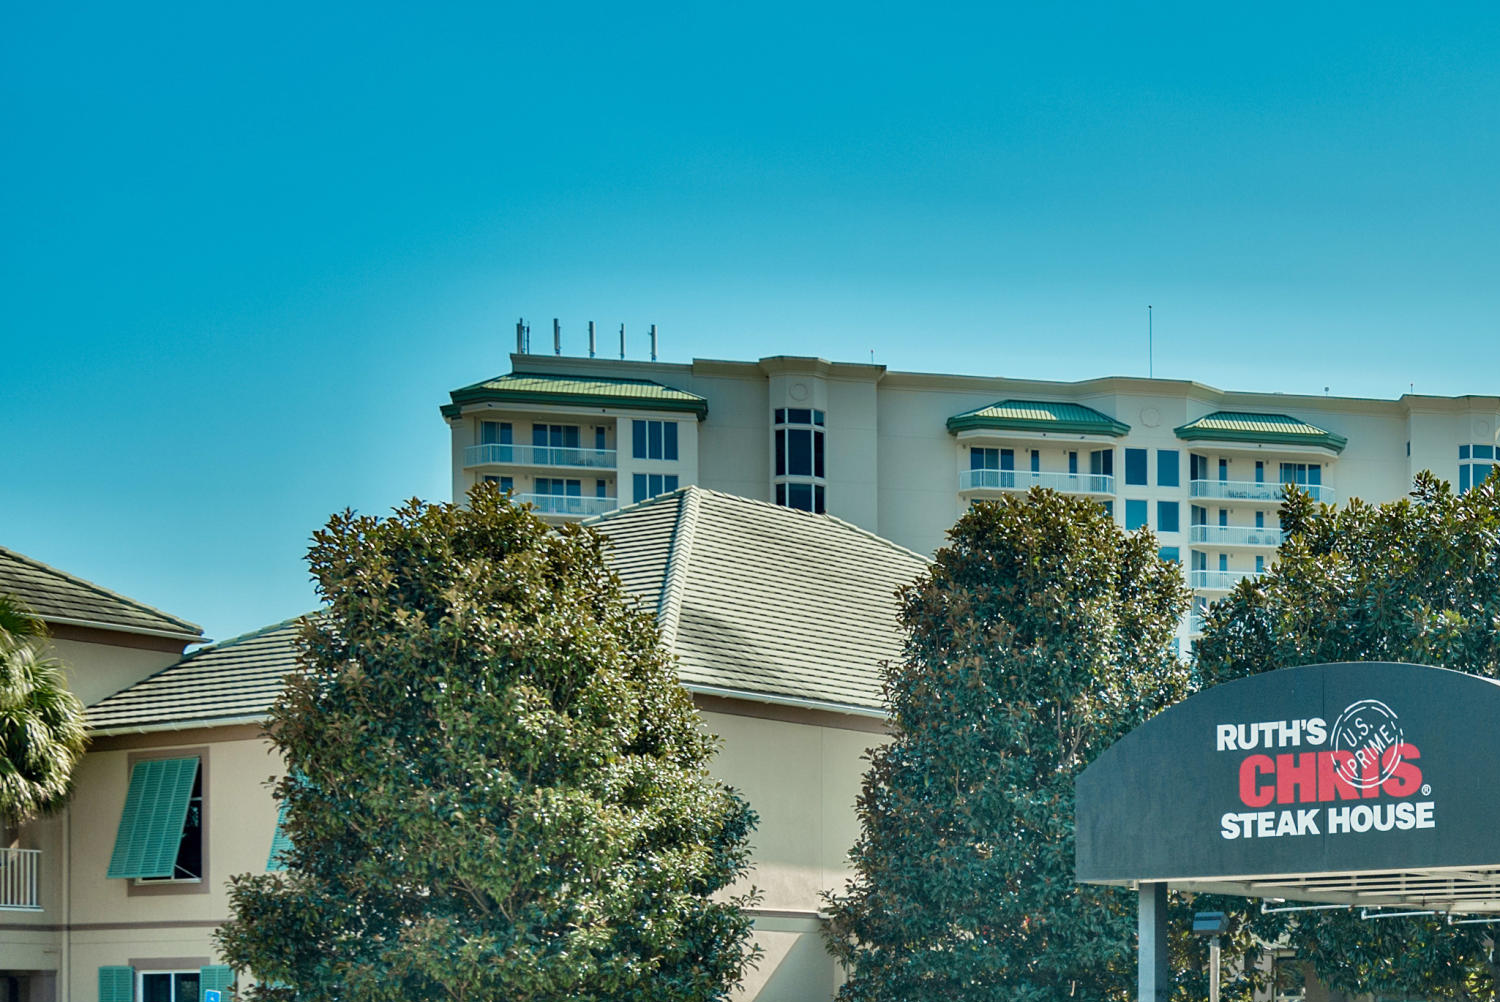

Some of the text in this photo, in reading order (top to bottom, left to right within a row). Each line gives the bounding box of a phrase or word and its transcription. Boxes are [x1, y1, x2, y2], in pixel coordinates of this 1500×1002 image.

[1216, 717, 1328, 752] RUTH'S
[1342, 717, 1374, 748] U.S.
[1346, 724, 1395, 778] PRIME
[1239, 743, 1423, 808] CHRIS
[1220, 801, 1436, 840] STEAK HOUSE
